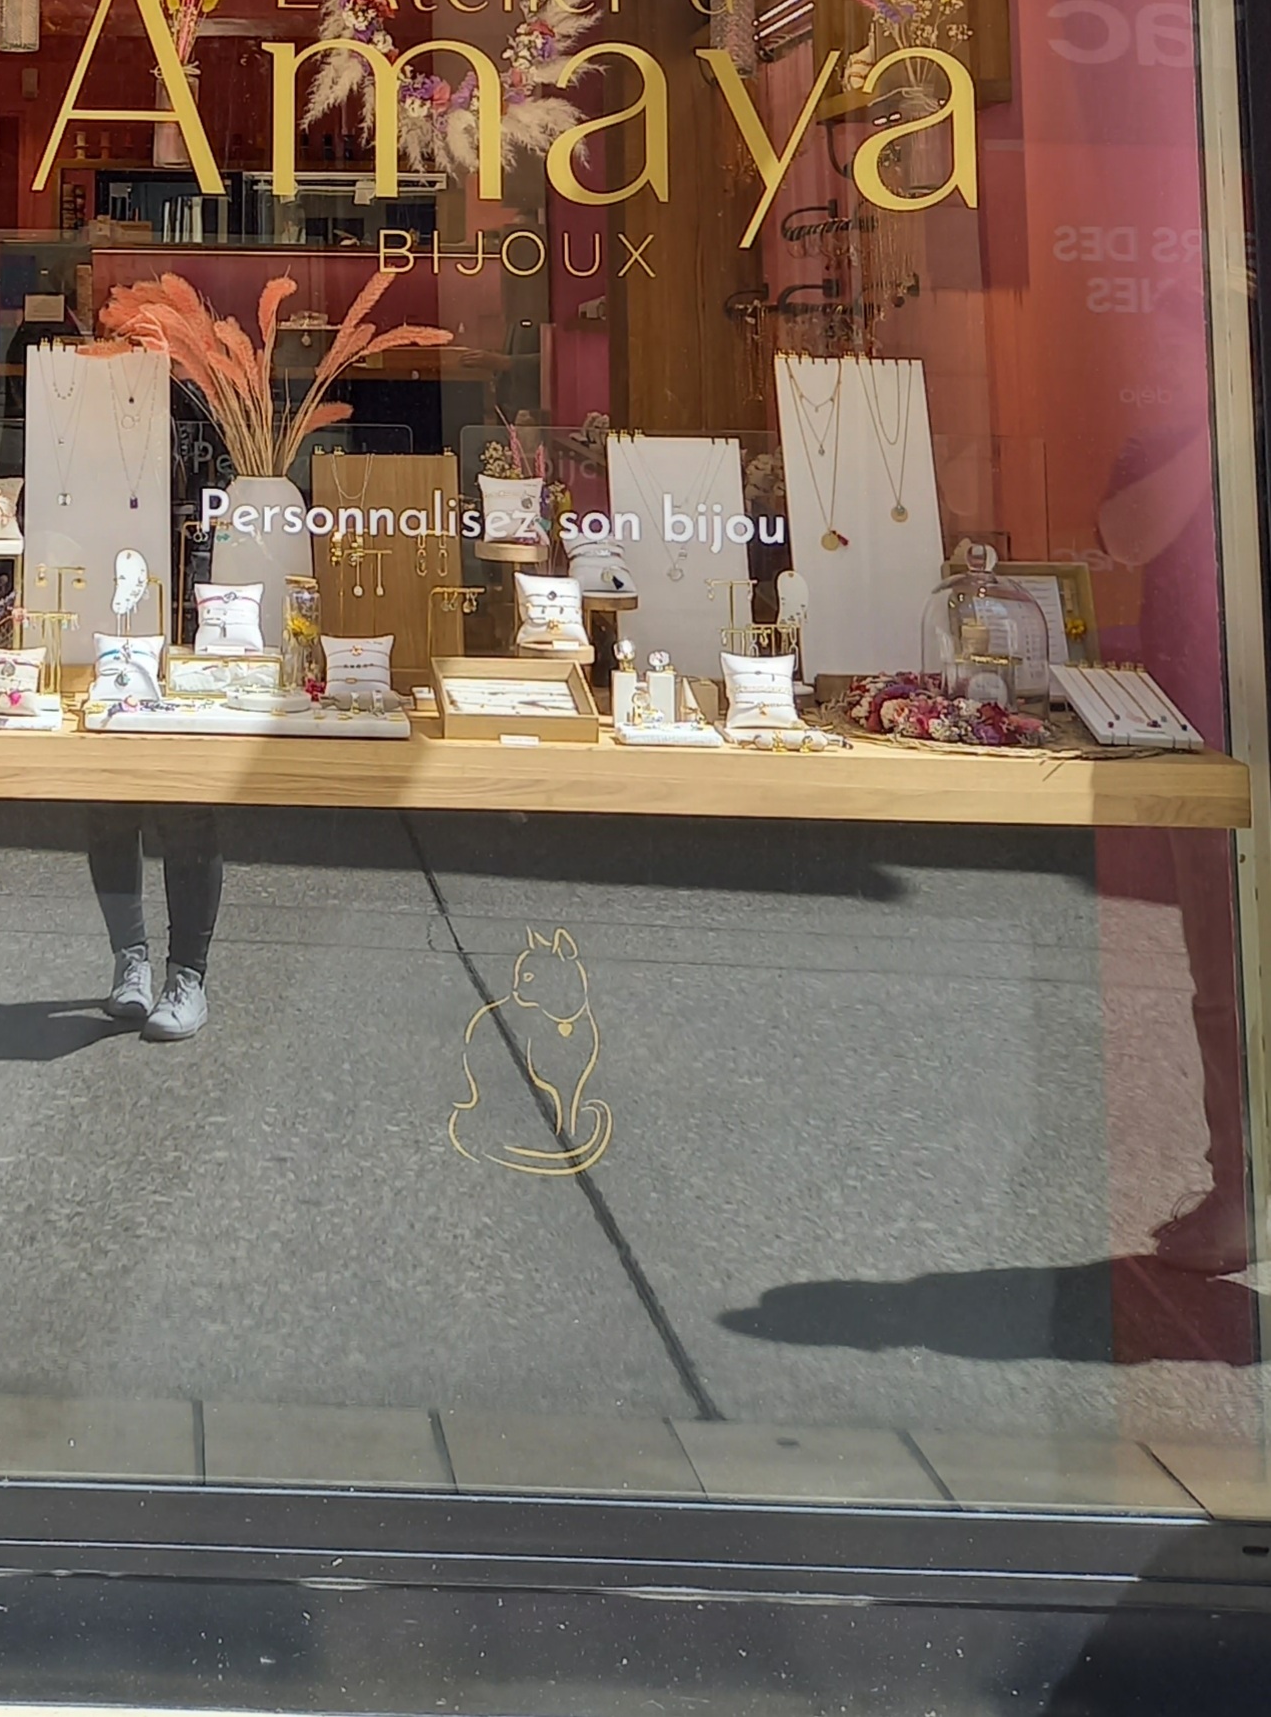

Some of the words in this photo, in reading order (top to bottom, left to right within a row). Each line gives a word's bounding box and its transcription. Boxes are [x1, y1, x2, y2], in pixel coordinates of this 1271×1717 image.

[376, 228, 657, 280] BIJOUX
[200, 487, 537, 538] Personnalisez
[559, 507, 642, 542] son
[662, 493, 787, 554] bijou
